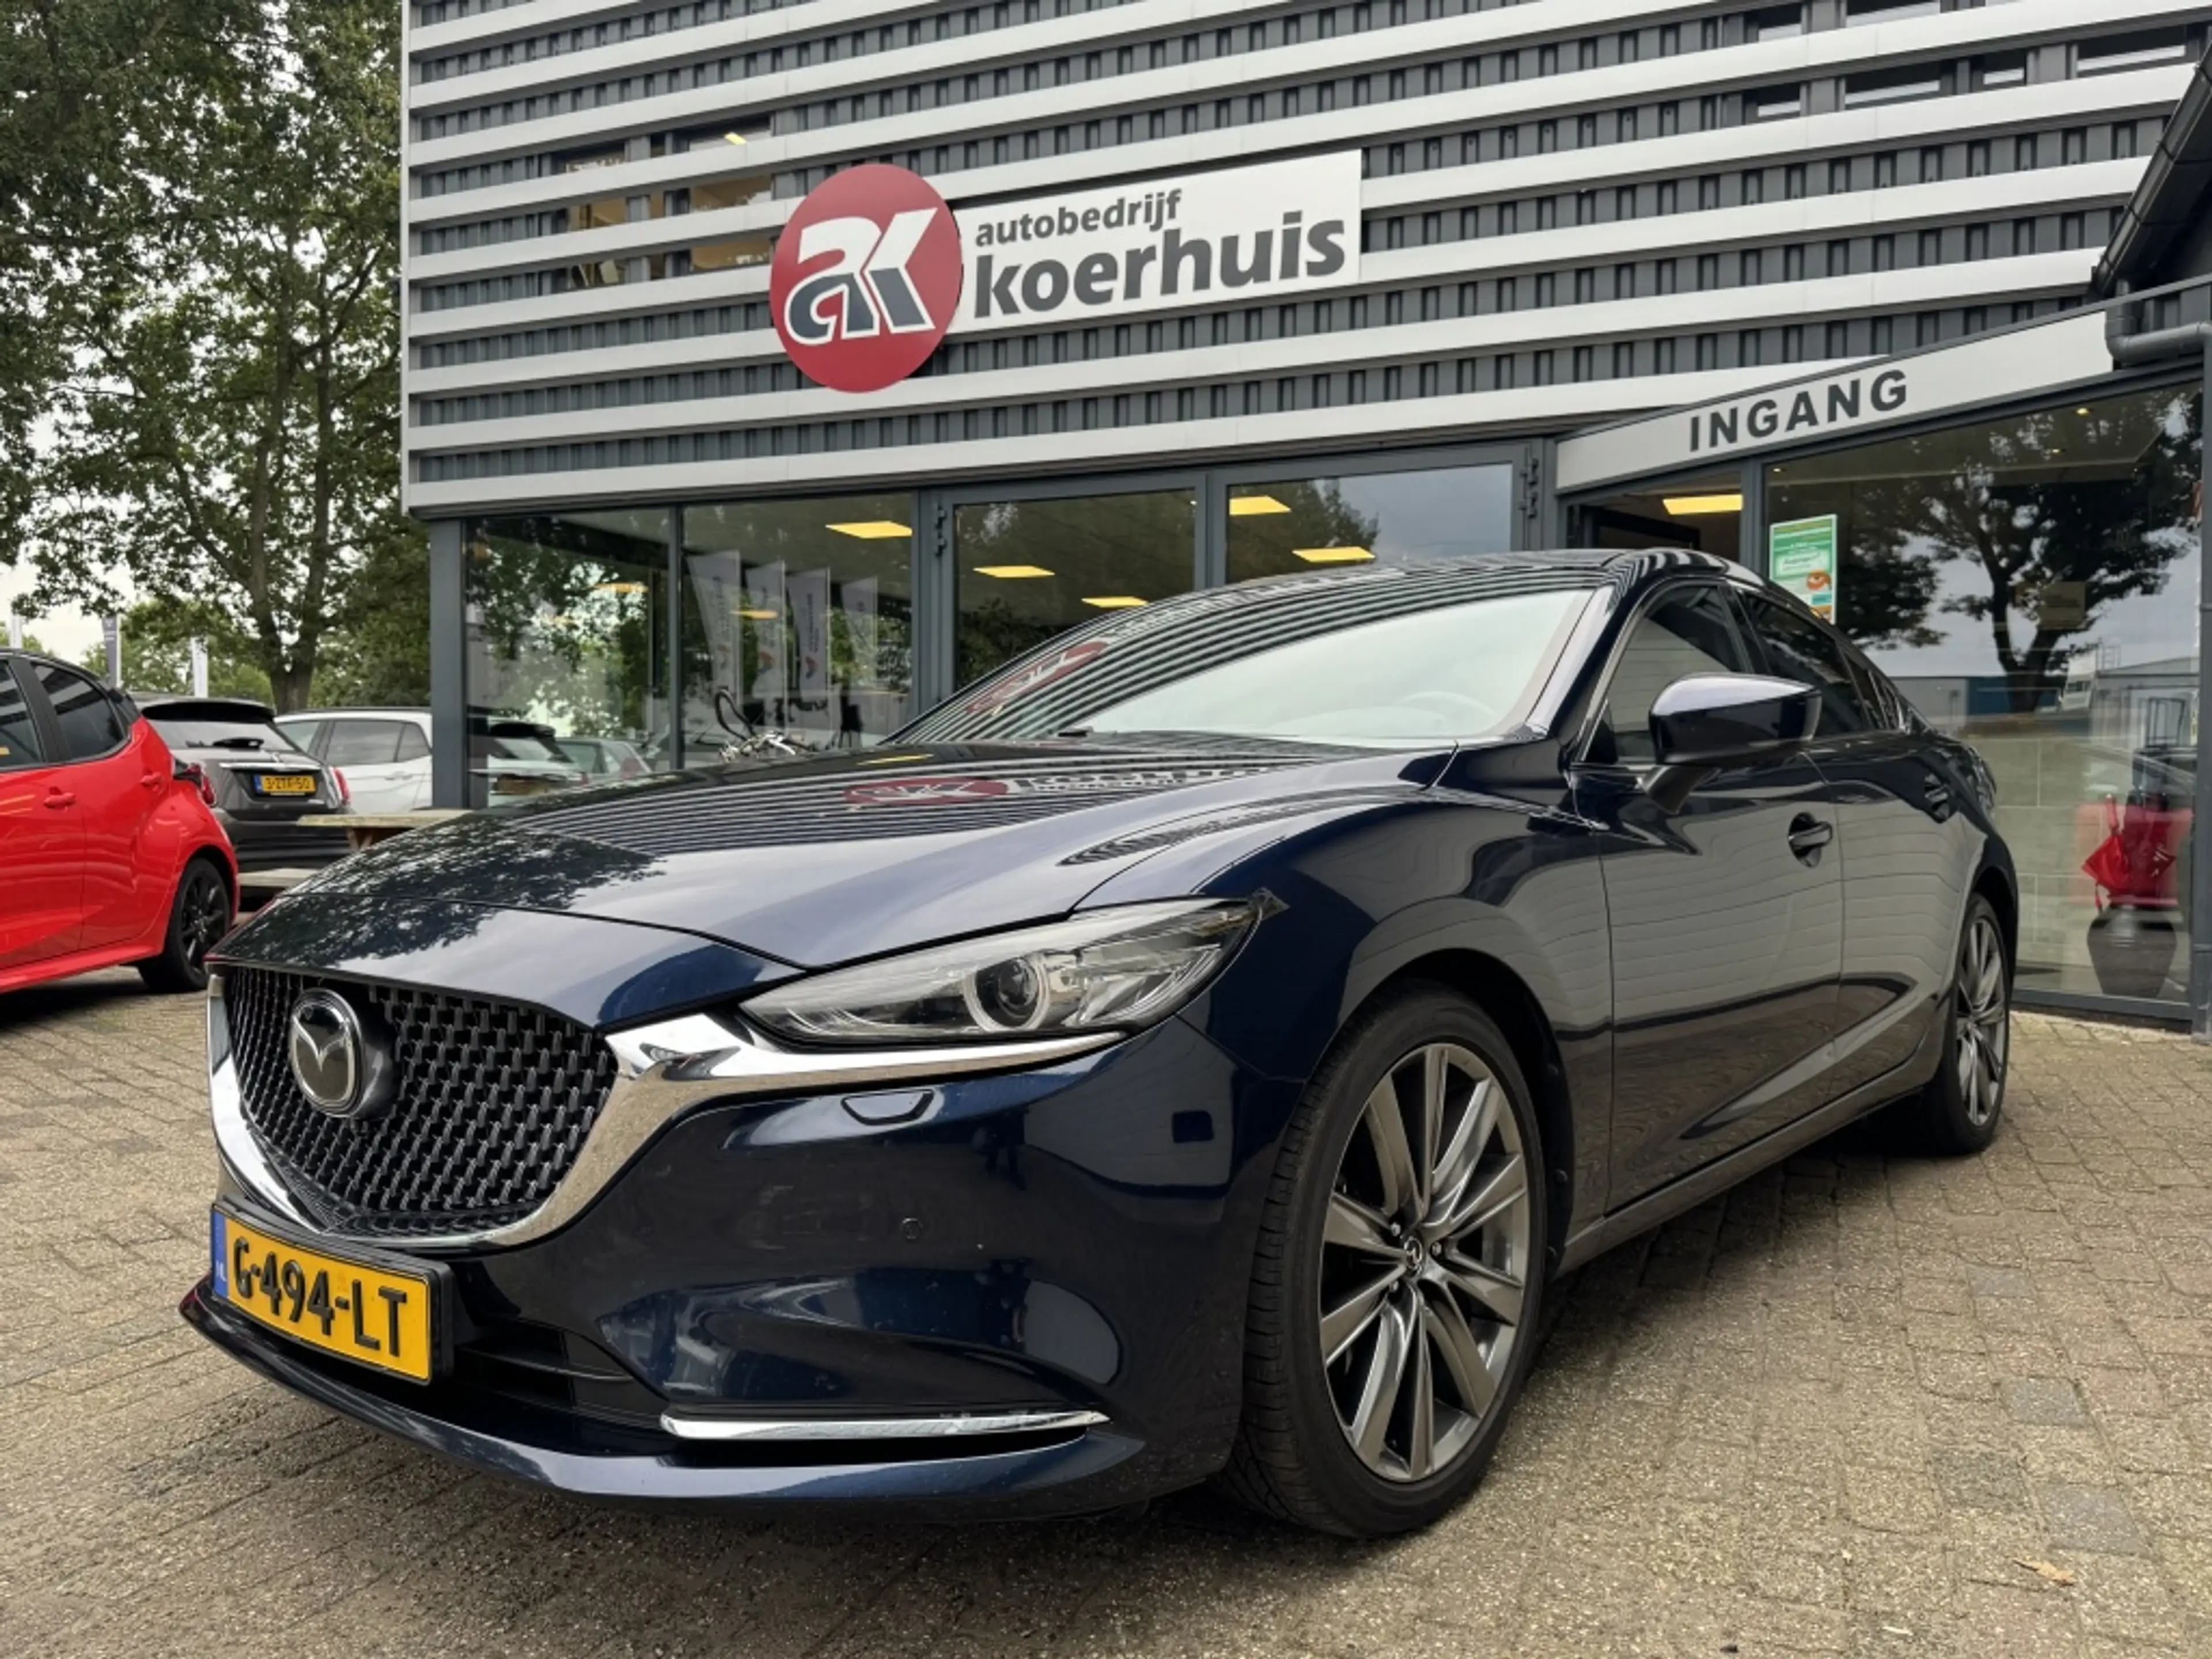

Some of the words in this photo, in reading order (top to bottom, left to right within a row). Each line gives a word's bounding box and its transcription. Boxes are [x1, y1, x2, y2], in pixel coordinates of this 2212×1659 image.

[974, 210, 1346, 319] koerhuis
[975, 188, 1183, 247] autobedrijf
[1690, 369, 1907, 453] INGANG
[233, 1236, 407, 1358] G-494-LT
